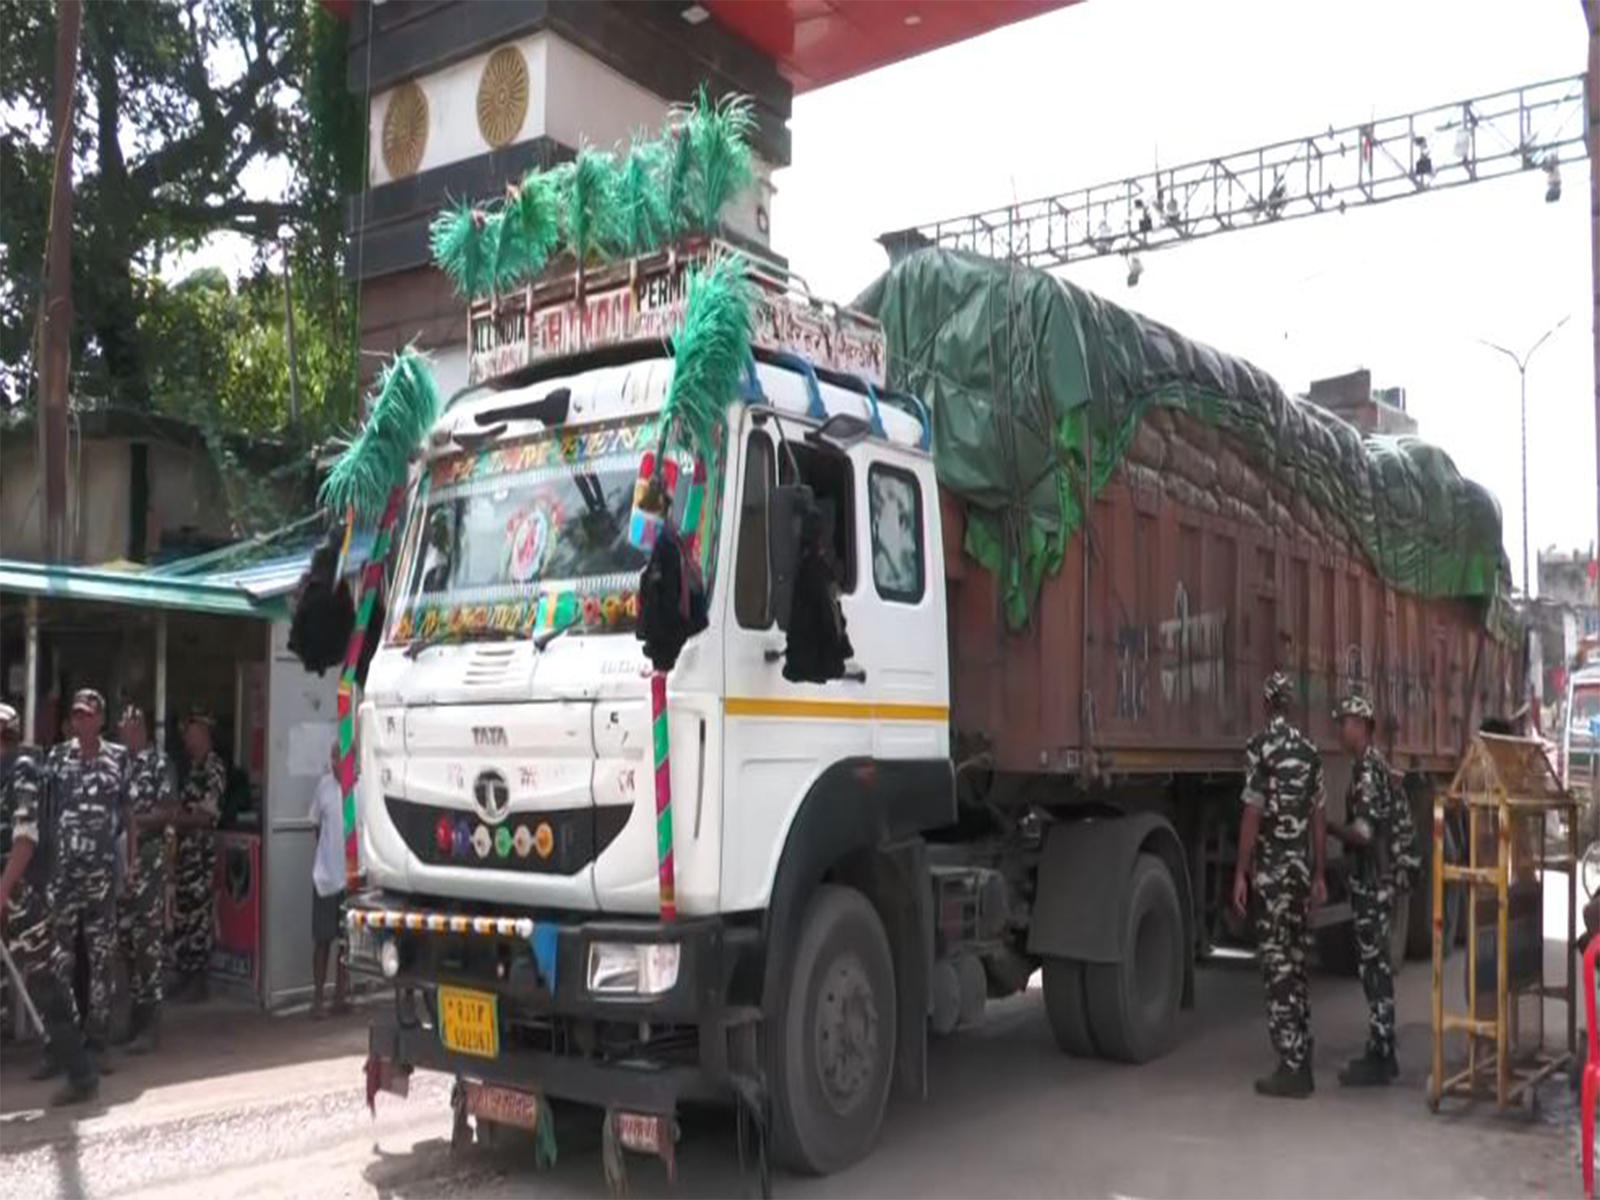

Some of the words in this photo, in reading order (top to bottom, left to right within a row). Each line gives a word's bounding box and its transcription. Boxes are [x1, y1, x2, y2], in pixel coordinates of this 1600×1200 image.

[473, 320, 493, 354] ALL
[637, 274, 687, 312] PERMI
[471, 726, 508, 746] TATA
